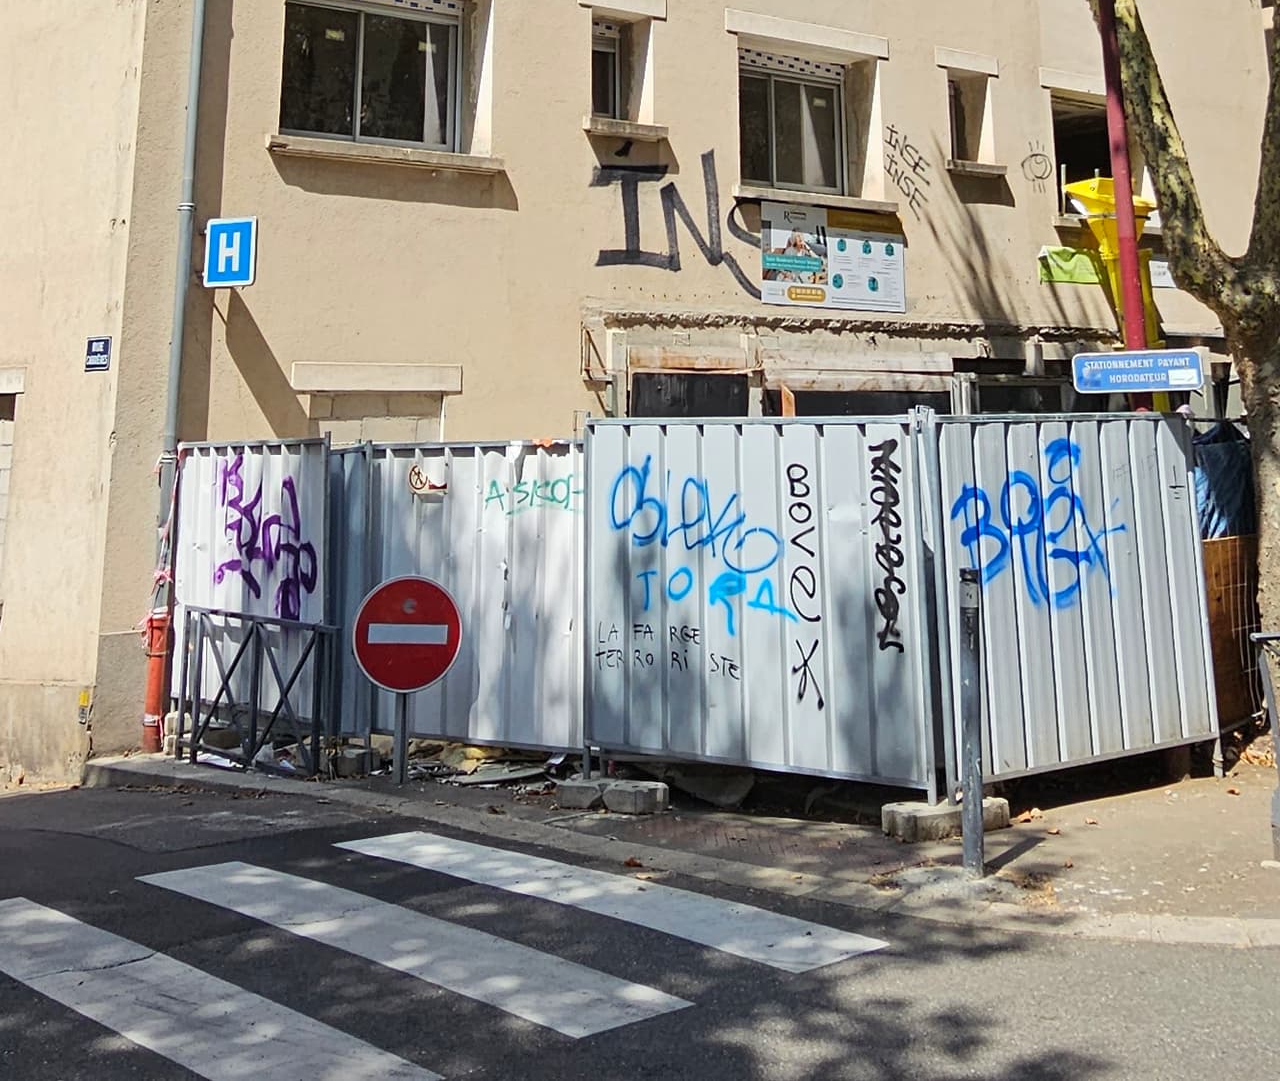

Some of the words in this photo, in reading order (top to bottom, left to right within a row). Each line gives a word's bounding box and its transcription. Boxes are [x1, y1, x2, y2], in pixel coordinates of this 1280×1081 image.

[884, 124, 931, 187] INSE
[883, 153, 929, 222] INSE
[217, 231, 242, 274] H
[1084, 358, 1154, 370] STATIONNEMENT
[1157, 357, 1190, 367] PAYANT
[1109, 372, 1168, 384] HORODATEUR
